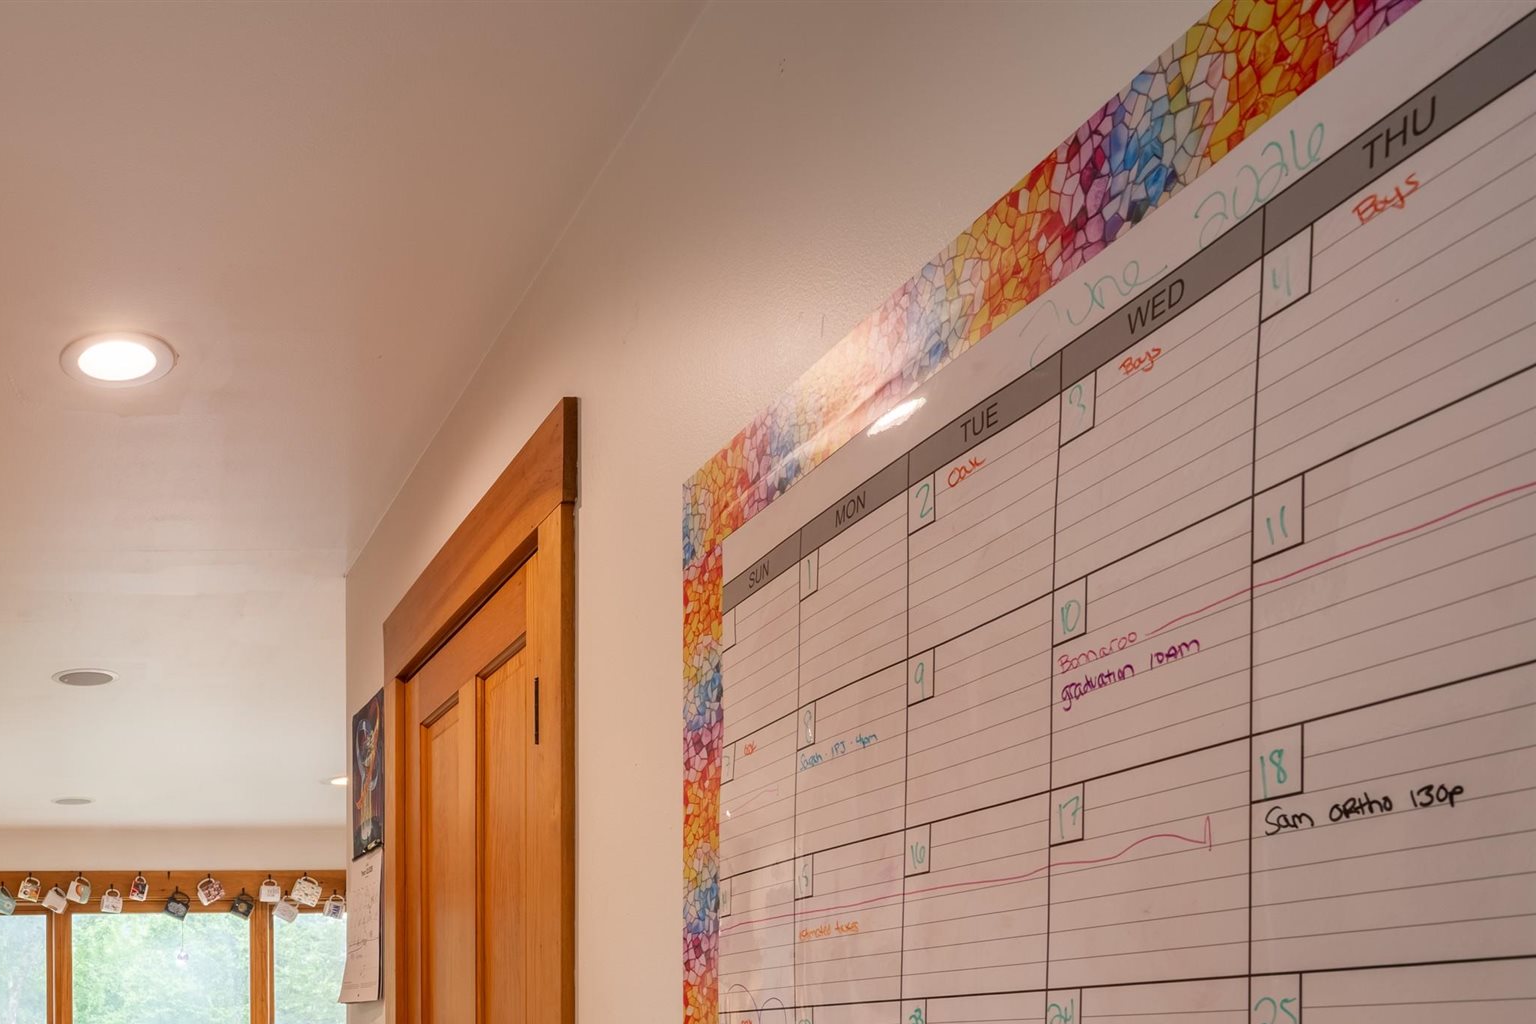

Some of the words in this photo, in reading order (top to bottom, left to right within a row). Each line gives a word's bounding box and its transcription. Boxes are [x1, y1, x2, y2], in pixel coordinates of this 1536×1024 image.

[748, 560, 770, 589] SUN
[835, 491, 866, 528] MON
[960, 402, 999, 442] TUE
[1127, 279, 1185, 335] WED
[1363, 96, 1437, 169] THU
[915, 483, 933, 518] 2
[914, 662, 925, 699] 9
[1061, 664, 1135, 712] graduation
[1260, 748, 1287, 800] 18
[1059, 795, 1080, 839] 17
[1265, 805, 1314, 836] Sam
[911, 841, 926, 870] 16
